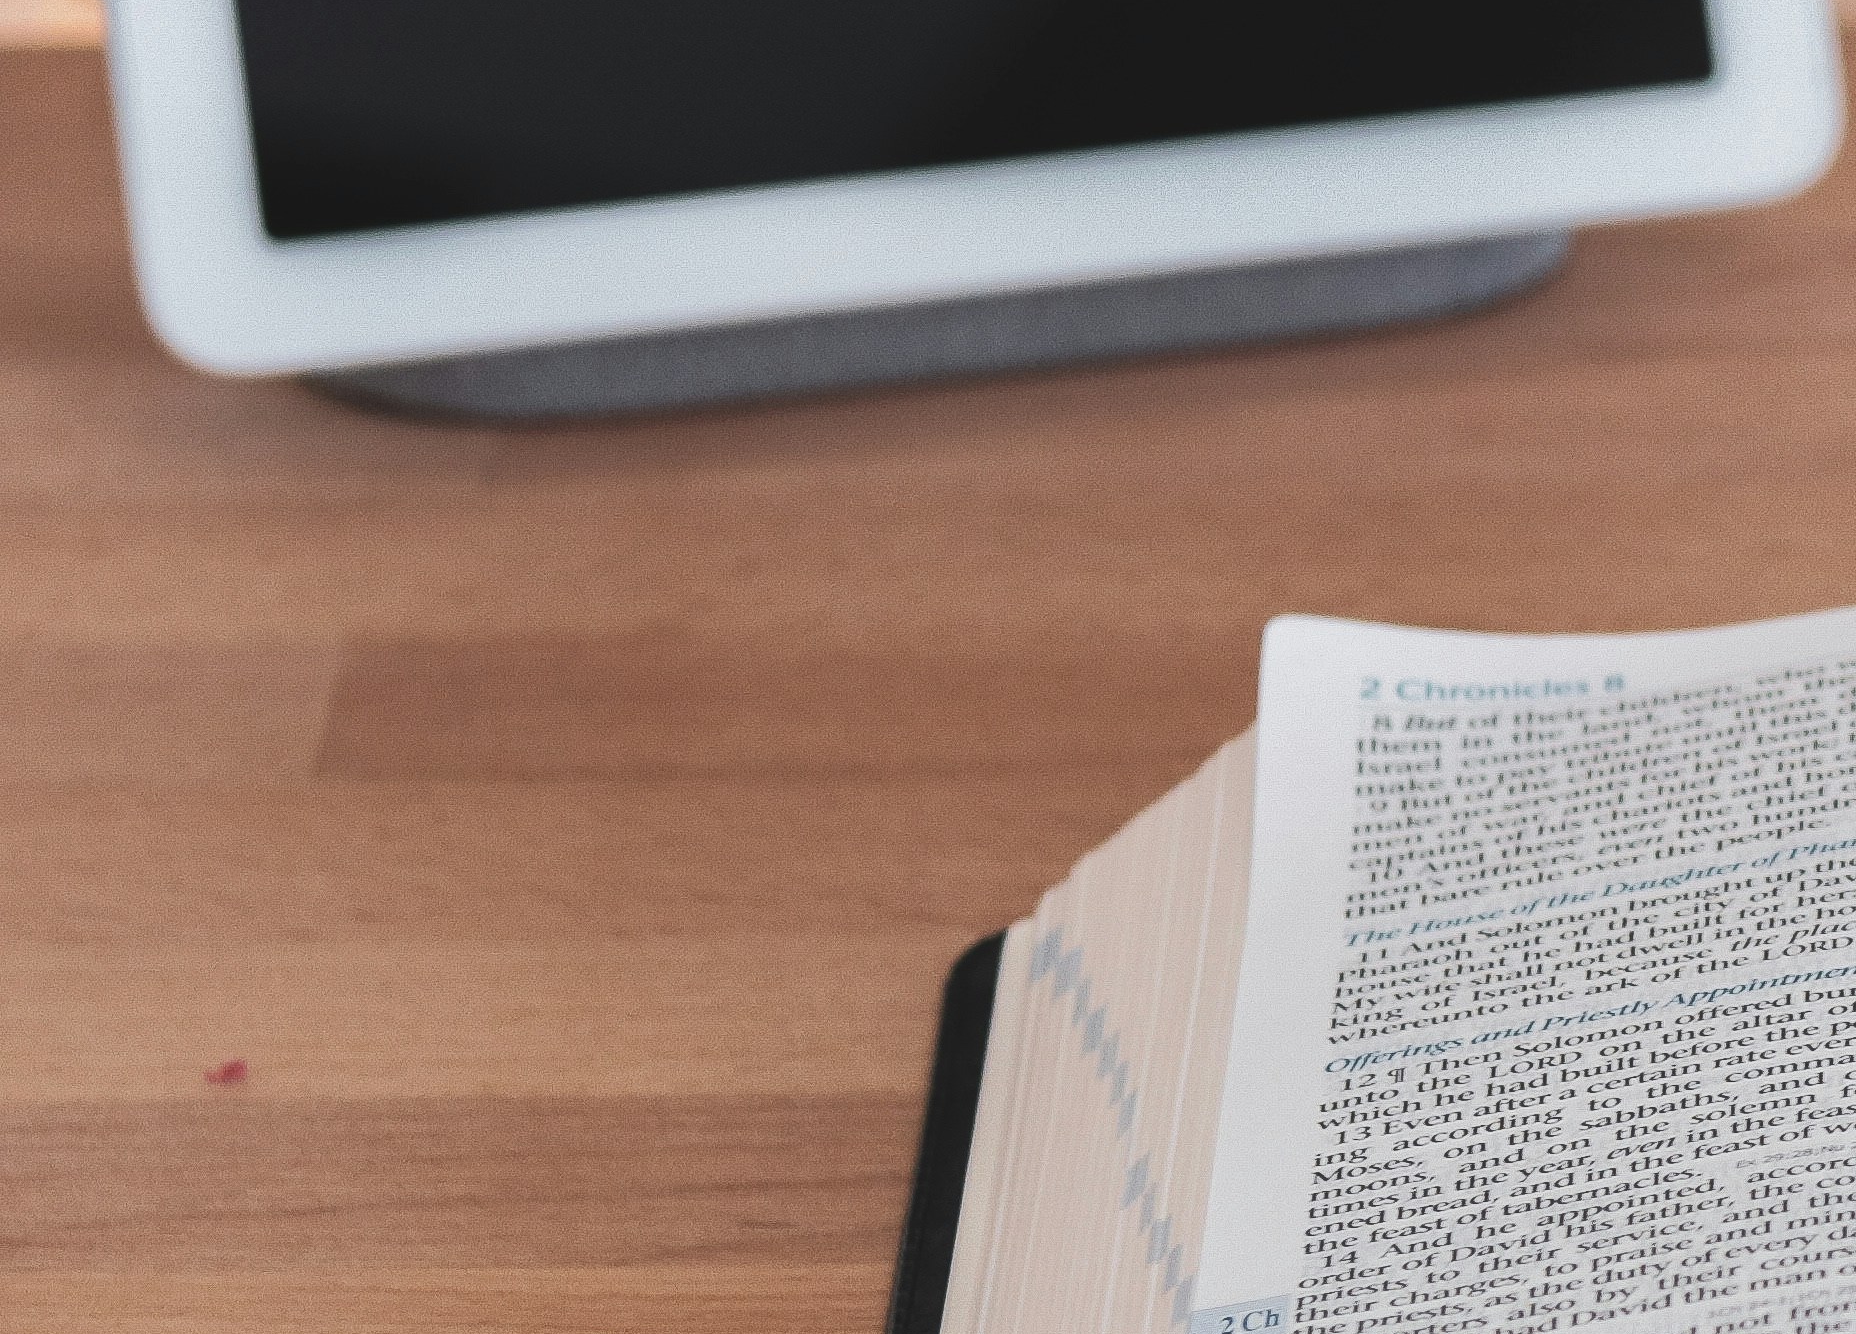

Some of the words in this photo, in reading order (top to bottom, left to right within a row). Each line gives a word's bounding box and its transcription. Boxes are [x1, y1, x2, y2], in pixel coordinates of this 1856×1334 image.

[1361, 675, 1381, 700] 2
[1395, 676, 1590, 700] Chronicles
[1348, 928, 1402, 947] The
[1409, 909, 1504, 936] House
[1510, 897, 1543, 916] of
[1547, 890, 1595, 909] the
[1601, 862, 1744, 898] Daughter
[1751, 850, 1782, 868] of
[1318, 1100, 1421, 1130] which
[1435, 1090, 1474, 1107] he
[1487, 1072, 1548, 1097] had
[1561, 1056, 1636, 1083] built
[1650, 1036, 1754, 1064] before
[1766, 1026, 1819, 1043] the
[1320, 1089, 1399, 1113] unto
[1418, 1074, 1470, 1093] the
[1490, 1051, 1582, 1079] LORD
[1599, 1040, 1642, 1057] on
[1662, 1026, 1715, 1045] the
[1732, 1010, 1812, 1032] altar
[1325, 1039, 1462, 1073] Offerings
[1471, 1020, 1535, 1045] and
[1541, 1000, 1658, 1031] Priestly
[1313, 1157, 1423, 1185] Moses,
[1444, 1142, 1486, 1159] on
[1508, 1126, 1561, 1146] the
[1580, 1092, 1738, 1131] sabbaths,
[1759, 1071, 1825, 1095] and
[1337, 1125, 1371, 1145] 13
[1383, 1110, 1462, 1135] Even
[1473, 1093, 1551, 1118] after
[1559, 1088, 1577, 1101] a
[1587, 1063, 1701, 1094] certain
[1714, 1049, 1776, 1069] rate
[1242, 1309, 1280, 1332] Ch
